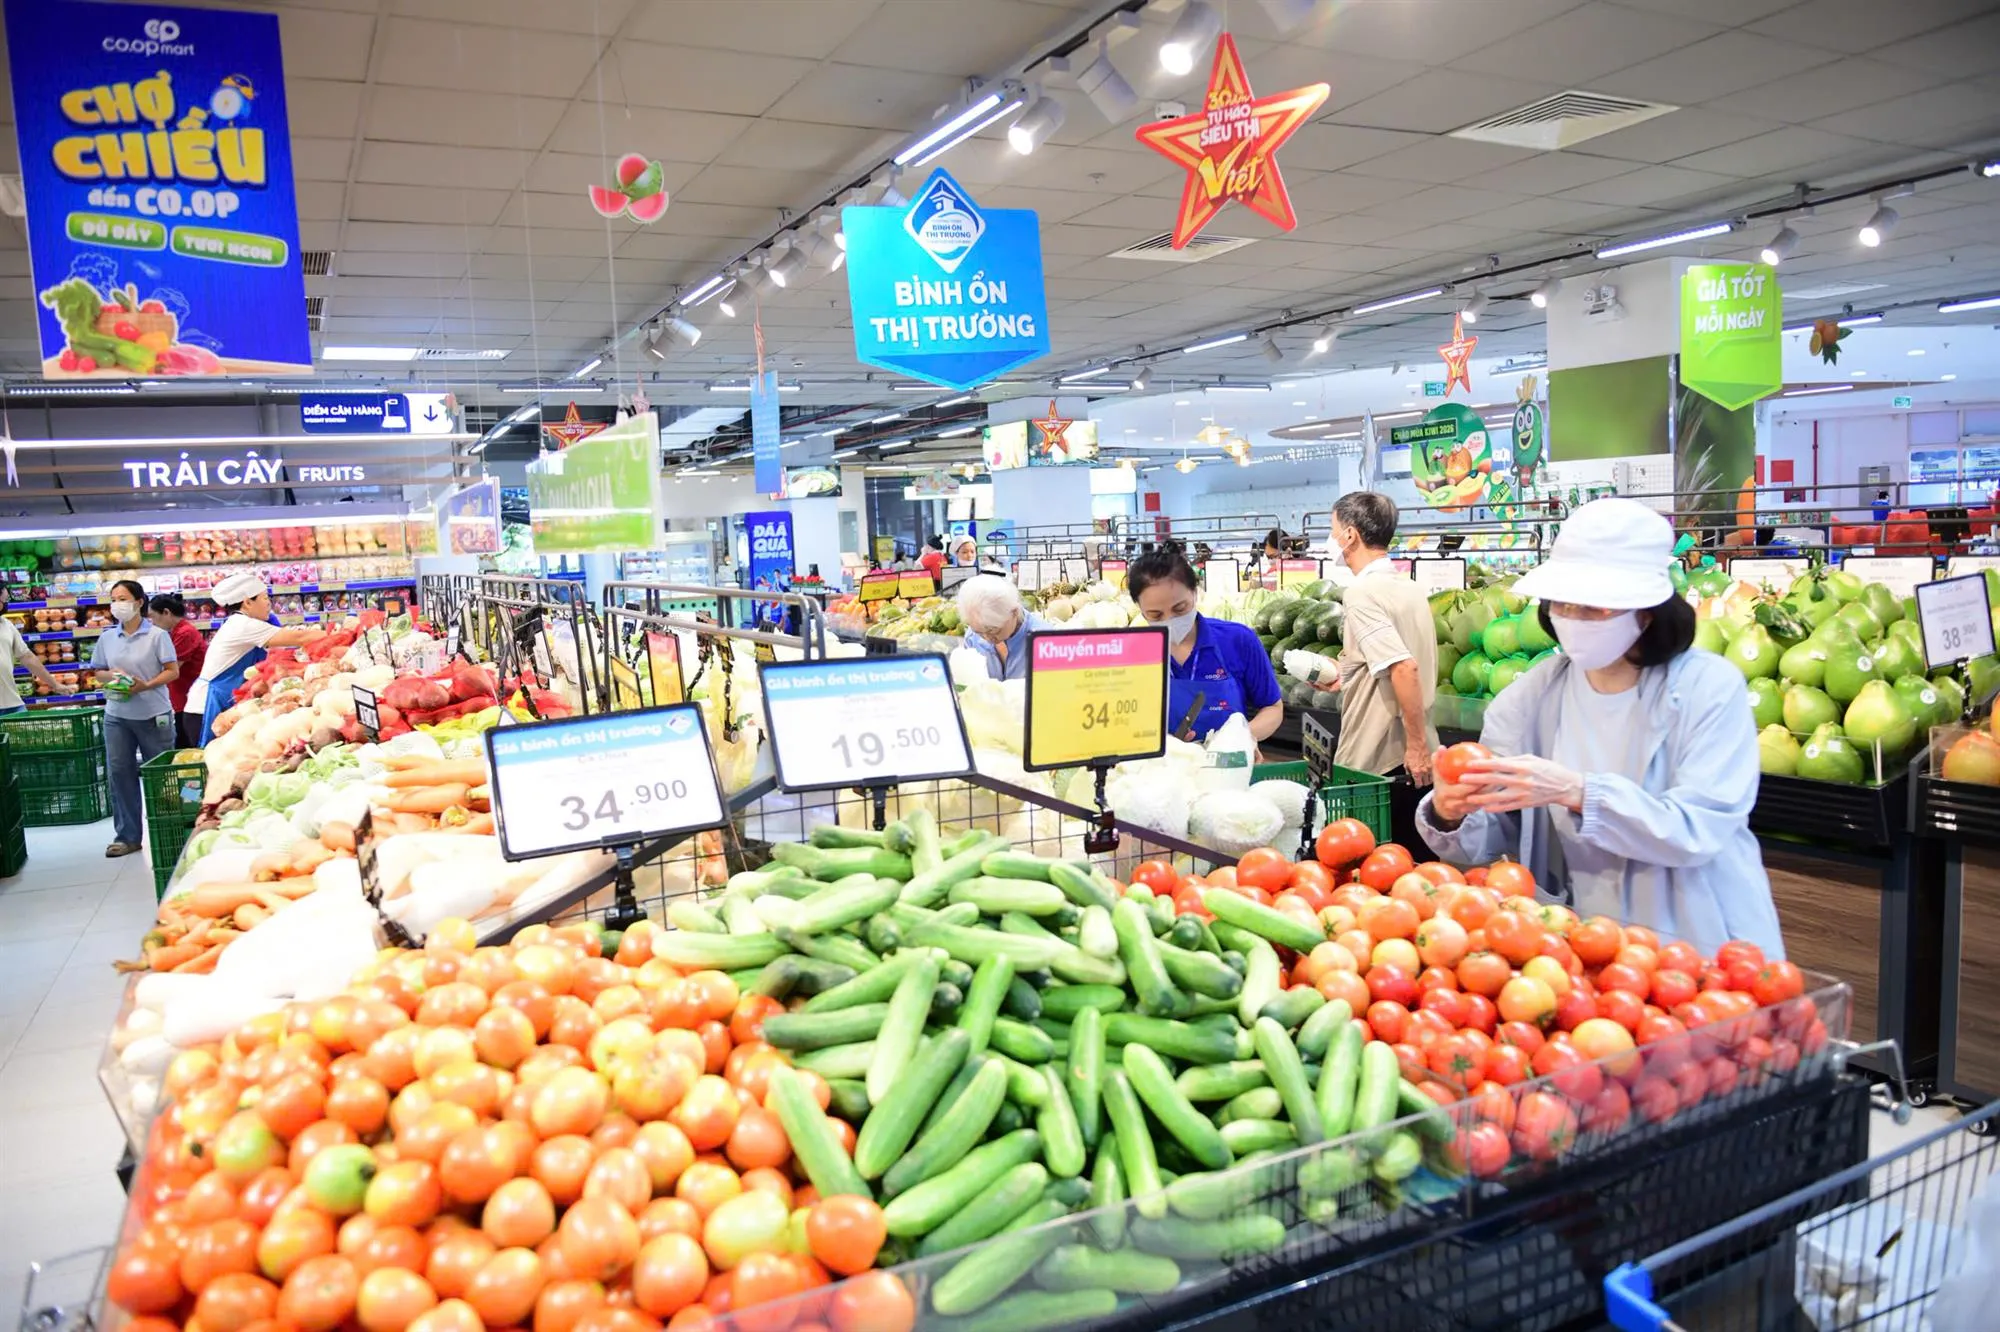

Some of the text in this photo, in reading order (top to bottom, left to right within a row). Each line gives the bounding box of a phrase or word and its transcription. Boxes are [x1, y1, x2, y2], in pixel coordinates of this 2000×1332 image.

[60, 69, 175, 130] CHỢ
[53, 106, 266, 185] CHIỀU
[1198, 136, 1265, 201] Việt
[88, 186, 240, 218] đến CO.OP
[894, 271, 1007, 306] BÌNH ỔN
[1697, 266, 1765, 302] GIÁ TỐT
[870, 309, 1036, 348] THỊ TRƯỜNG
[1695, 304, 1765, 334] MỖI NGÀY
[123, 451, 365, 487] TRÁI CÂY FRUITS
[1039, 638, 1123, 661] Khuyến mãi
[1942, 627, 1961, 650] 38
